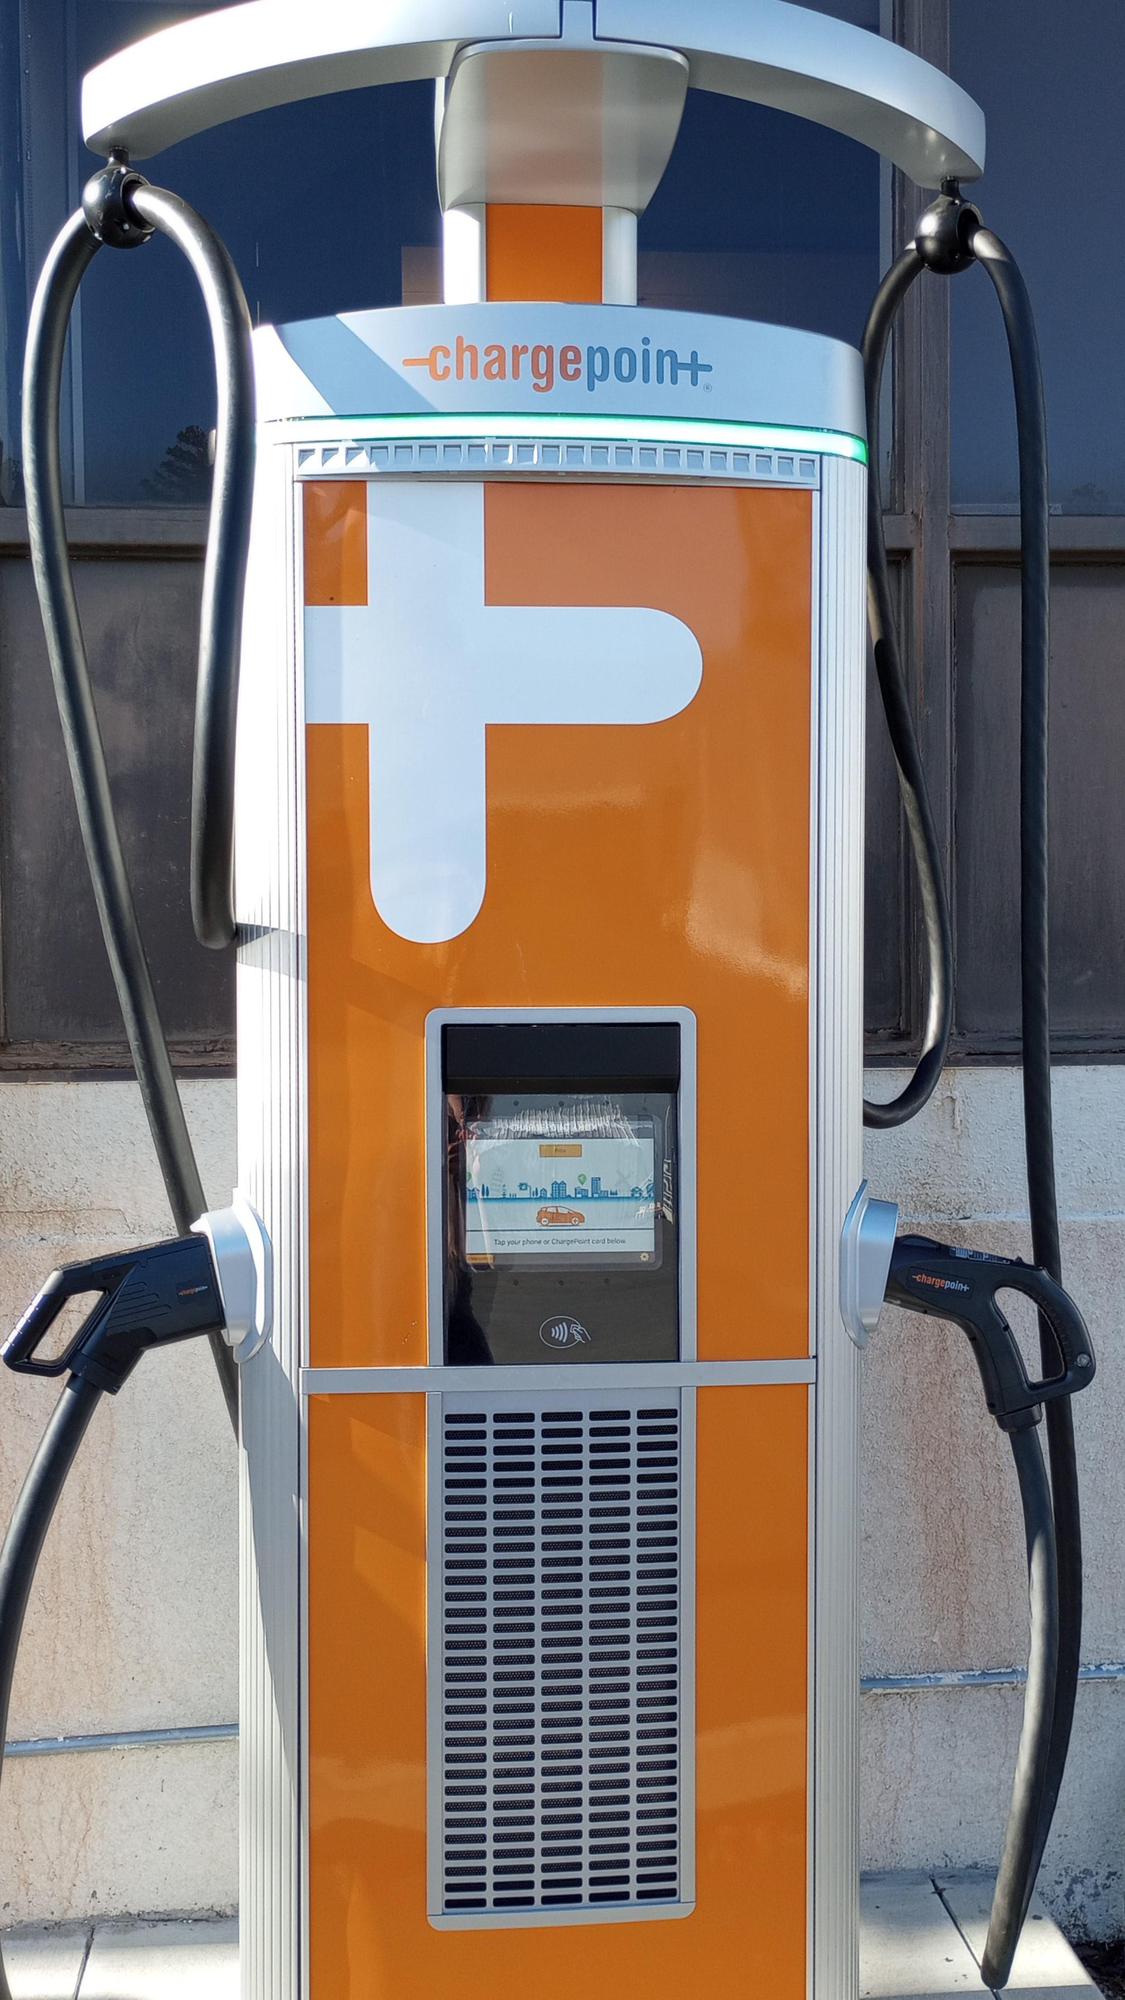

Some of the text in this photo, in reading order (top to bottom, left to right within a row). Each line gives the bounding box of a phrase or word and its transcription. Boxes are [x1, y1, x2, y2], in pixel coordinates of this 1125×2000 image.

[494, 1239, 506, 1247] Tap
[522, 1238, 542, 1247] phone
[551, 1238, 590, 1247] ChargePoint
[591, 1237, 606, 1245] card
